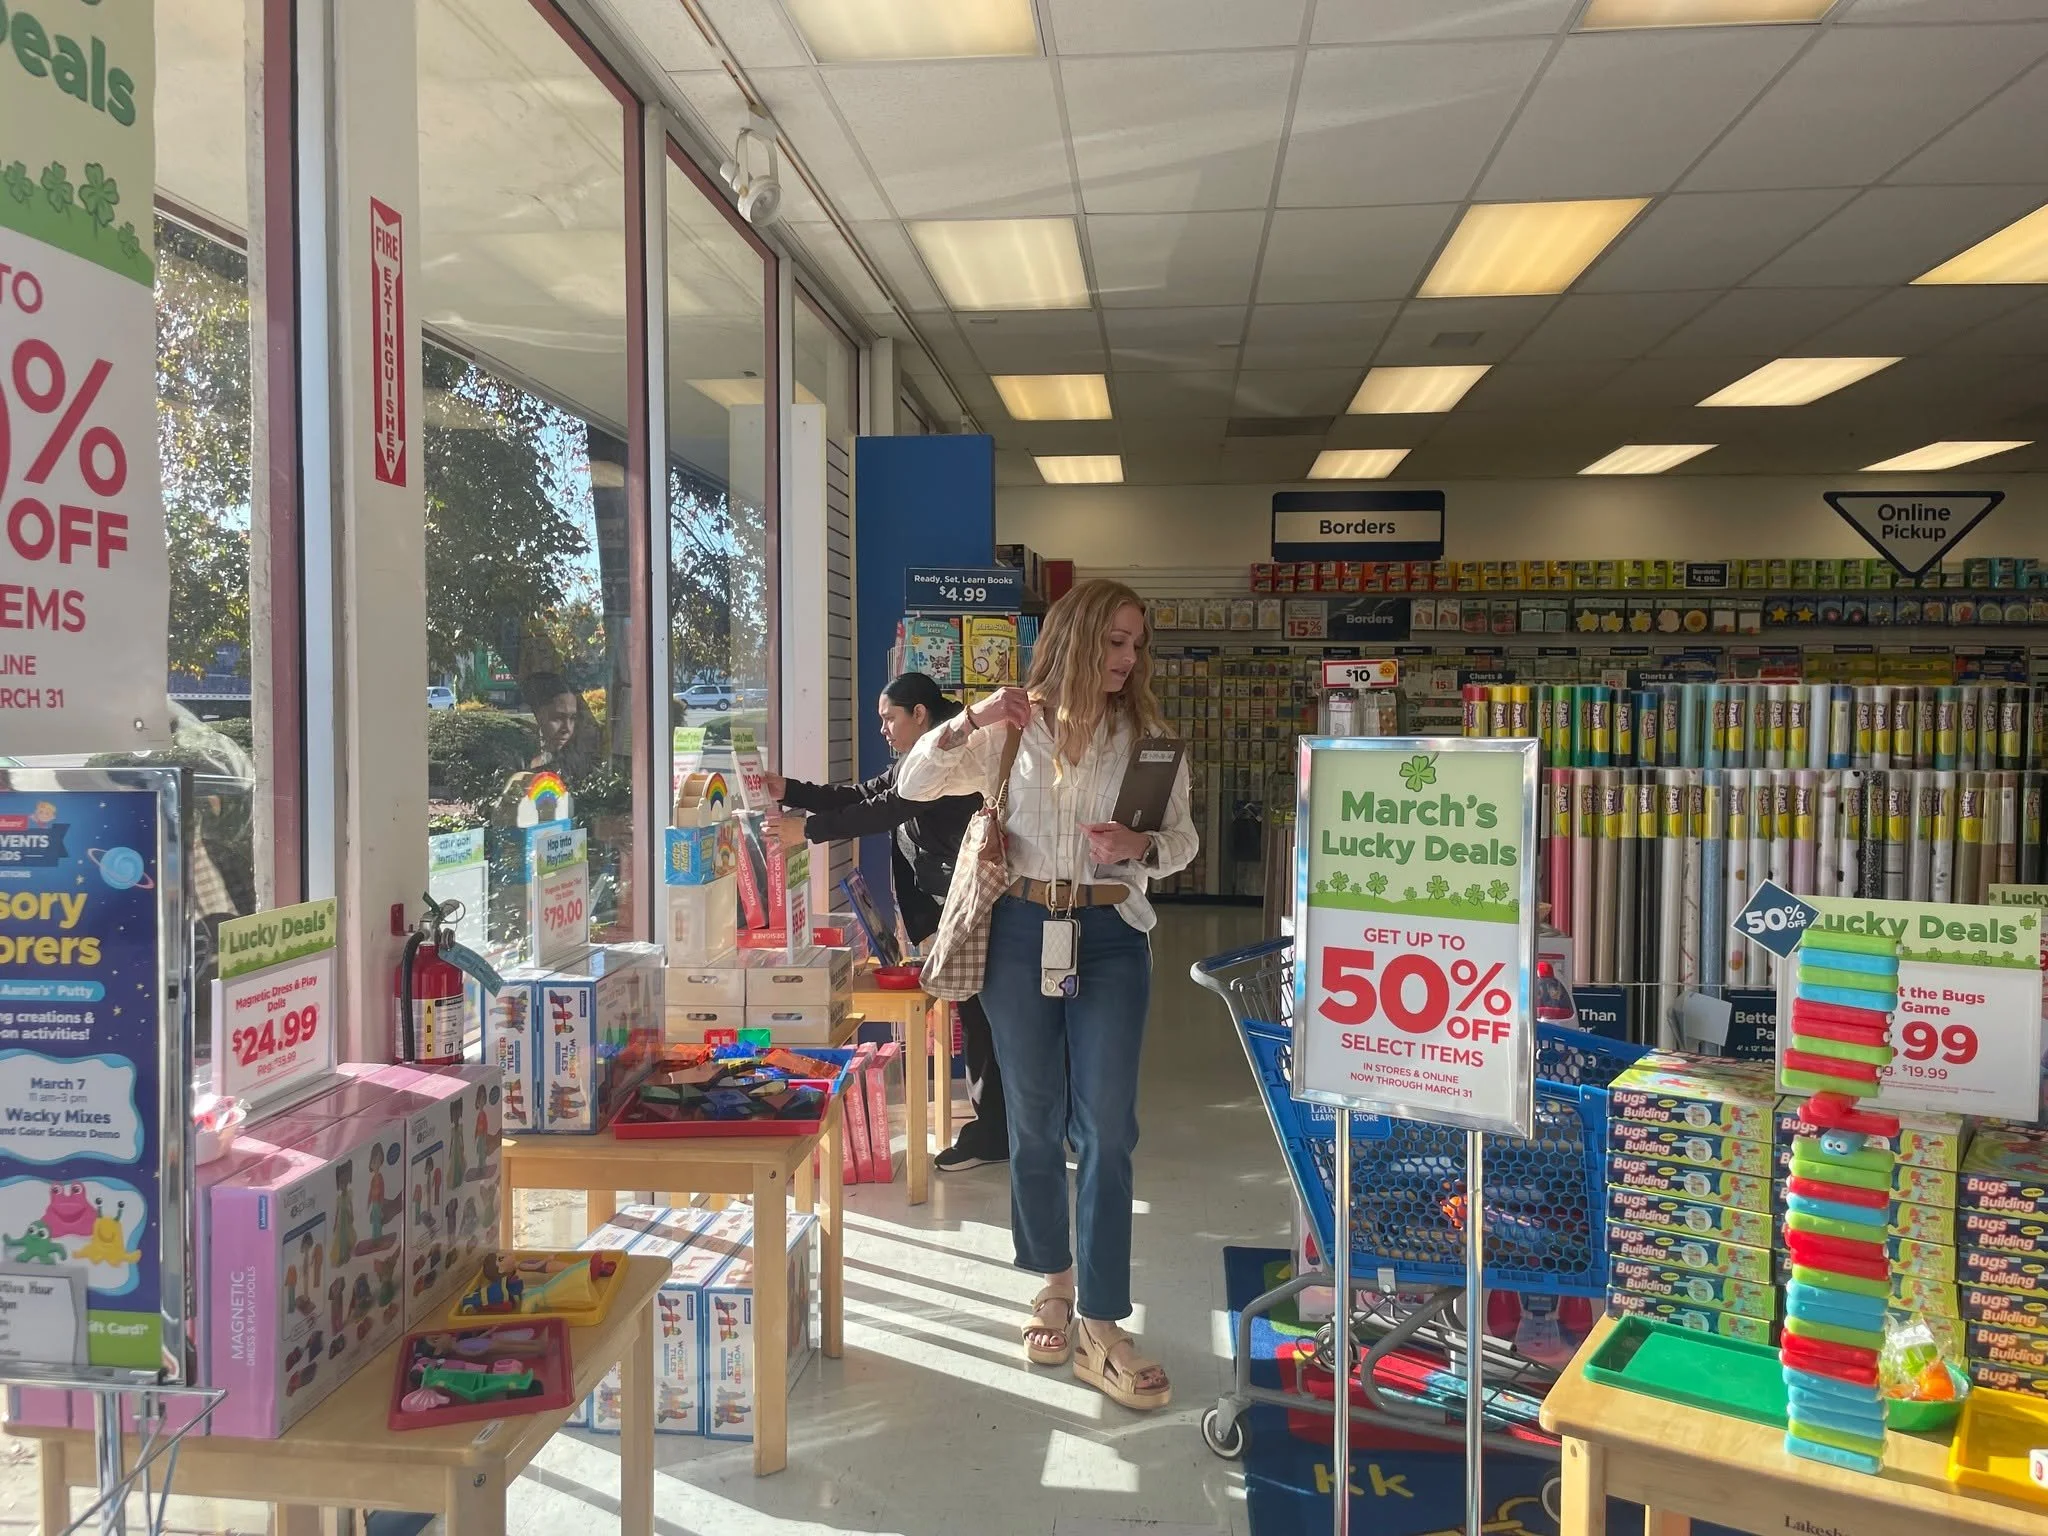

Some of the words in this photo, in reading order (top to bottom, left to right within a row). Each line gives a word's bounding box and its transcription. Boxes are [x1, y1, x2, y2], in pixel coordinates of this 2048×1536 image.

[0, 4, 136, 127] eals
[375, 228, 400, 262] FIRE
[381, 266, 396, 464] EXTINGUISHER
[1878, 503, 1950, 522] Online
[7, 498, 128, 568] OFF
[1319, 519, 1396, 535] Borders
[1882, 524, 1946, 542] Pickup
[914, 574, 943, 585] Ready,
[962, 575, 986, 584] Learn
[987, 576, 1013, 585] Books
[939, 586, 987, 602] $4.99
[1346, 611, 1394, 624] Borders
[1288, 620, 1322, 636] 15%
[1346, 669, 1371, 682] $10
[1469, 672, 1495, 681] Charts
[1639, 672, 1667, 681] Charts
[47, 689, 64, 708] 31
[1341, 790, 1497, 829] March's
[547, 838, 558, 852] Hop
[559, 836, 572, 848] into
[1322, 830, 1416, 865] Lucky
[1424, 835, 1517, 866] Deals
[0, 891, 88, 929] sory
[544, 898, 583, 931] $79.00
[1745, 904, 1805, 935] 50%
[1787, 917, 1807, 929] OFF
[229, 923, 278, 954] Lucky
[282, 912, 326, 940] Deals
[1812, 911, 1909, 938] ucky
[1919, 914, 2018, 945] Deals
[1364, 927, 1401, 945] GET
[1406, 931, 1433, 948] UP
[1438, 934, 1466, 951] TO
[57, 985, 94, 999] Putty
[236, 988, 270, 1011] Magnetic
[272, 981, 293, 998] Dress
[301, 975, 318, 990] Play
[1318, 946, 1512, 1034] 50%
[1910, 986, 1938, 1000] the
[1943, 989, 1985, 1004] Bugs
[267, 998, 286, 1012] Dolls
[426, 1005, 432, 1015] A
[1901, 1001, 1951, 1016] Game
[16, 1011, 81, 1023] creations
[84, 1012, 95, 1024] &
[1579, 1008, 1617, 1022] Than
[1735, 1012, 1776, 1025] Bette
[21, 1028, 90, 1041] activities!
[232, 1003, 319, 1067] $24.99
[426, 1024, 432, 1034] B
[1446, 1016, 1511, 1044] OFF
[426, 1043, 432, 1053] C
[1341, 1033, 1416, 1058] SELECT
[1421, 1043, 1484, 1068] ITEMS
[1892, 1020, 1979, 1065] .99
[568, 1039, 576, 1080] WONDER
[1363, 1062, 1373, 1072] IN
[1375, 1064, 1412, 1077] STORES
[1413, 1069, 1420, 1078] &
[1422, 1070, 1460, 1084] ONLINE
[1902, 1064, 1949, 1079] $19.99
[31, 1078, 73, 1090] March
[76, 1079, 86, 1090] 7
[1350, 1071, 1374, 1083] NOW
[1376, 1075, 1423, 1091] THROUGH
[1424, 1083, 1461, 1097] MARCH
[1463, 1089, 1473, 1099] 31
[1613, 1091, 1647, 1105] Bugs
[5, 1108, 60, 1125] Wacky
[65, 1109, 111, 1124] Mixes
[1311, 1113, 1337, 1122] LEARN
[1353, 1113, 1379, 1123] STORE
[1624, 1107, 1669, 1122] Building
[18, 1128, 46, 1137] Color
[48, 1129, 87, 1138] Science
[89, 1130, 120, 1139] Demo
[1614, 1124, 1648, 1138] Bugs
[1624, 1140, 1670, 1155] Building
[1613, 1158, 1647, 1172] Bugs
[1623, 1174, 1669, 1189] Building
[1967, 1178, 2008, 1195] Bugs
[1614, 1192, 1648, 1207] Bugs
[1980, 1196, 2034, 1213] Building
[1624, 1209, 1670, 1224] Building
[1967, 1216, 2007, 1232] Bugs
[1611, 1227, 1644, 1241] Bugs
[1979, 1233, 2034, 1250] Building
[1621, 1243, 1667, 1259] Building
[1616, 1262, 1649, 1277] Bugs
[1968, 1253, 2008, 1270] Bugs
[247, 1265, 256, 1298] DOLLS
[1626, 1279, 1672, 1295] Building
[1980, 1271, 2035, 1288] Building
[1612, 1294, 1645, 1308] Bugs
[1970, 1292, 2009, 1308] Bugs
[231, 1271, 245, 1360] MAGNETIC
[247, 1299, 256, 1324] PLAY
[1982, 1309, 2037, 1327] Building
[1977, 1330, 2017, 1346] Bugs
[247, 1335, 256, 1367] DRESS
[1989, 1347, 2044, 1364] Building
[1978, 1368, 2017, 1384] Bugs
[1784, 1511, 1846, 1536] Lakesh
